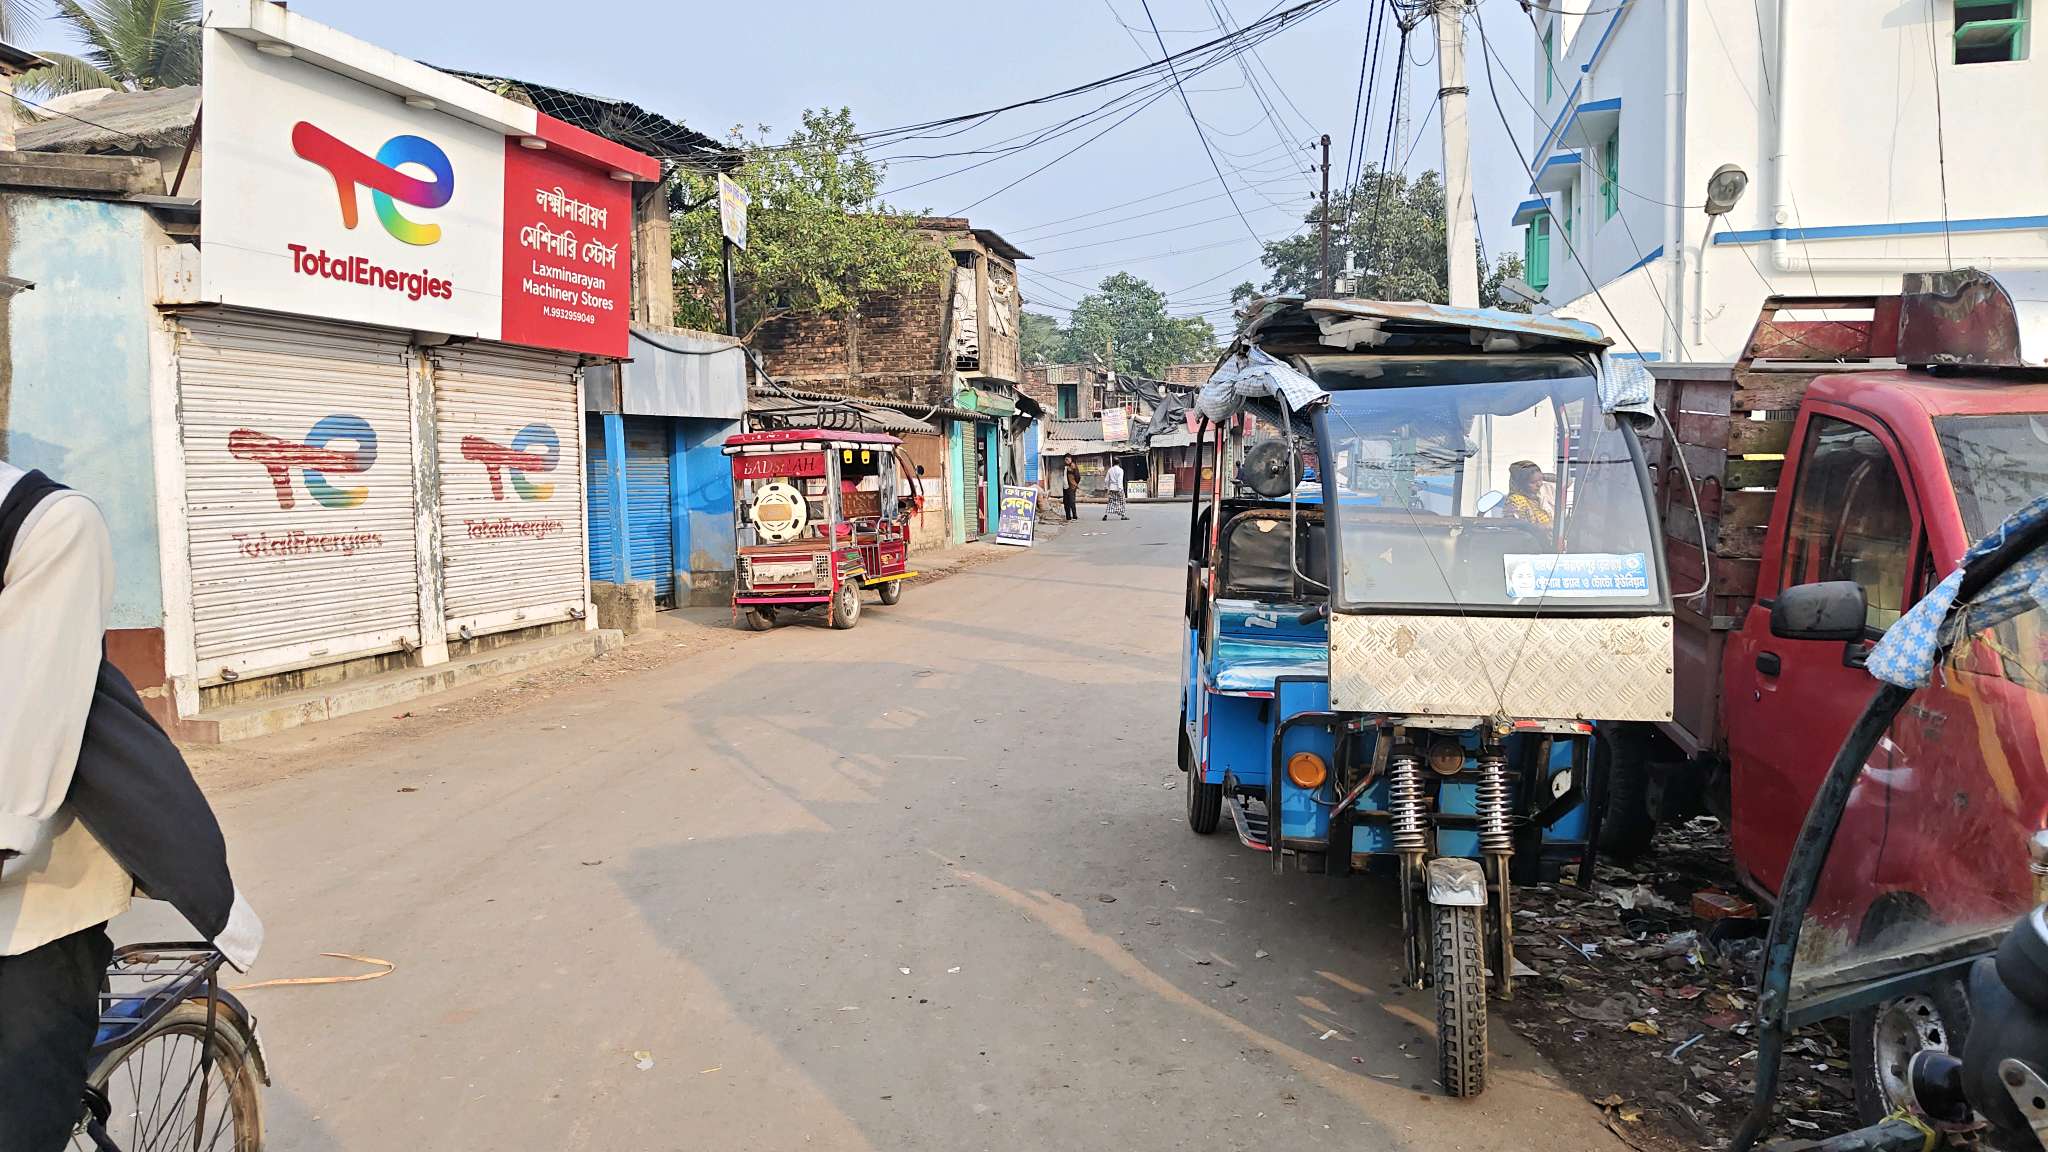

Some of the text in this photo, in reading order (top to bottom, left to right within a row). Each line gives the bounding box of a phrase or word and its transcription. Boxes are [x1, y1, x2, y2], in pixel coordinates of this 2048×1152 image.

[536, 187, 608, 230] লক্ষ্মীনারায়ণ
[520, 222, 618, 270] মেশিনারি স্টোর্স
[287, 243, 452, 301] TotalEnergies
[532, 260, 605, 290] Laxminarayan
[523, 278, 614, 310] Machinery Stores
[543, 306, 595, 324] M.9932959049
